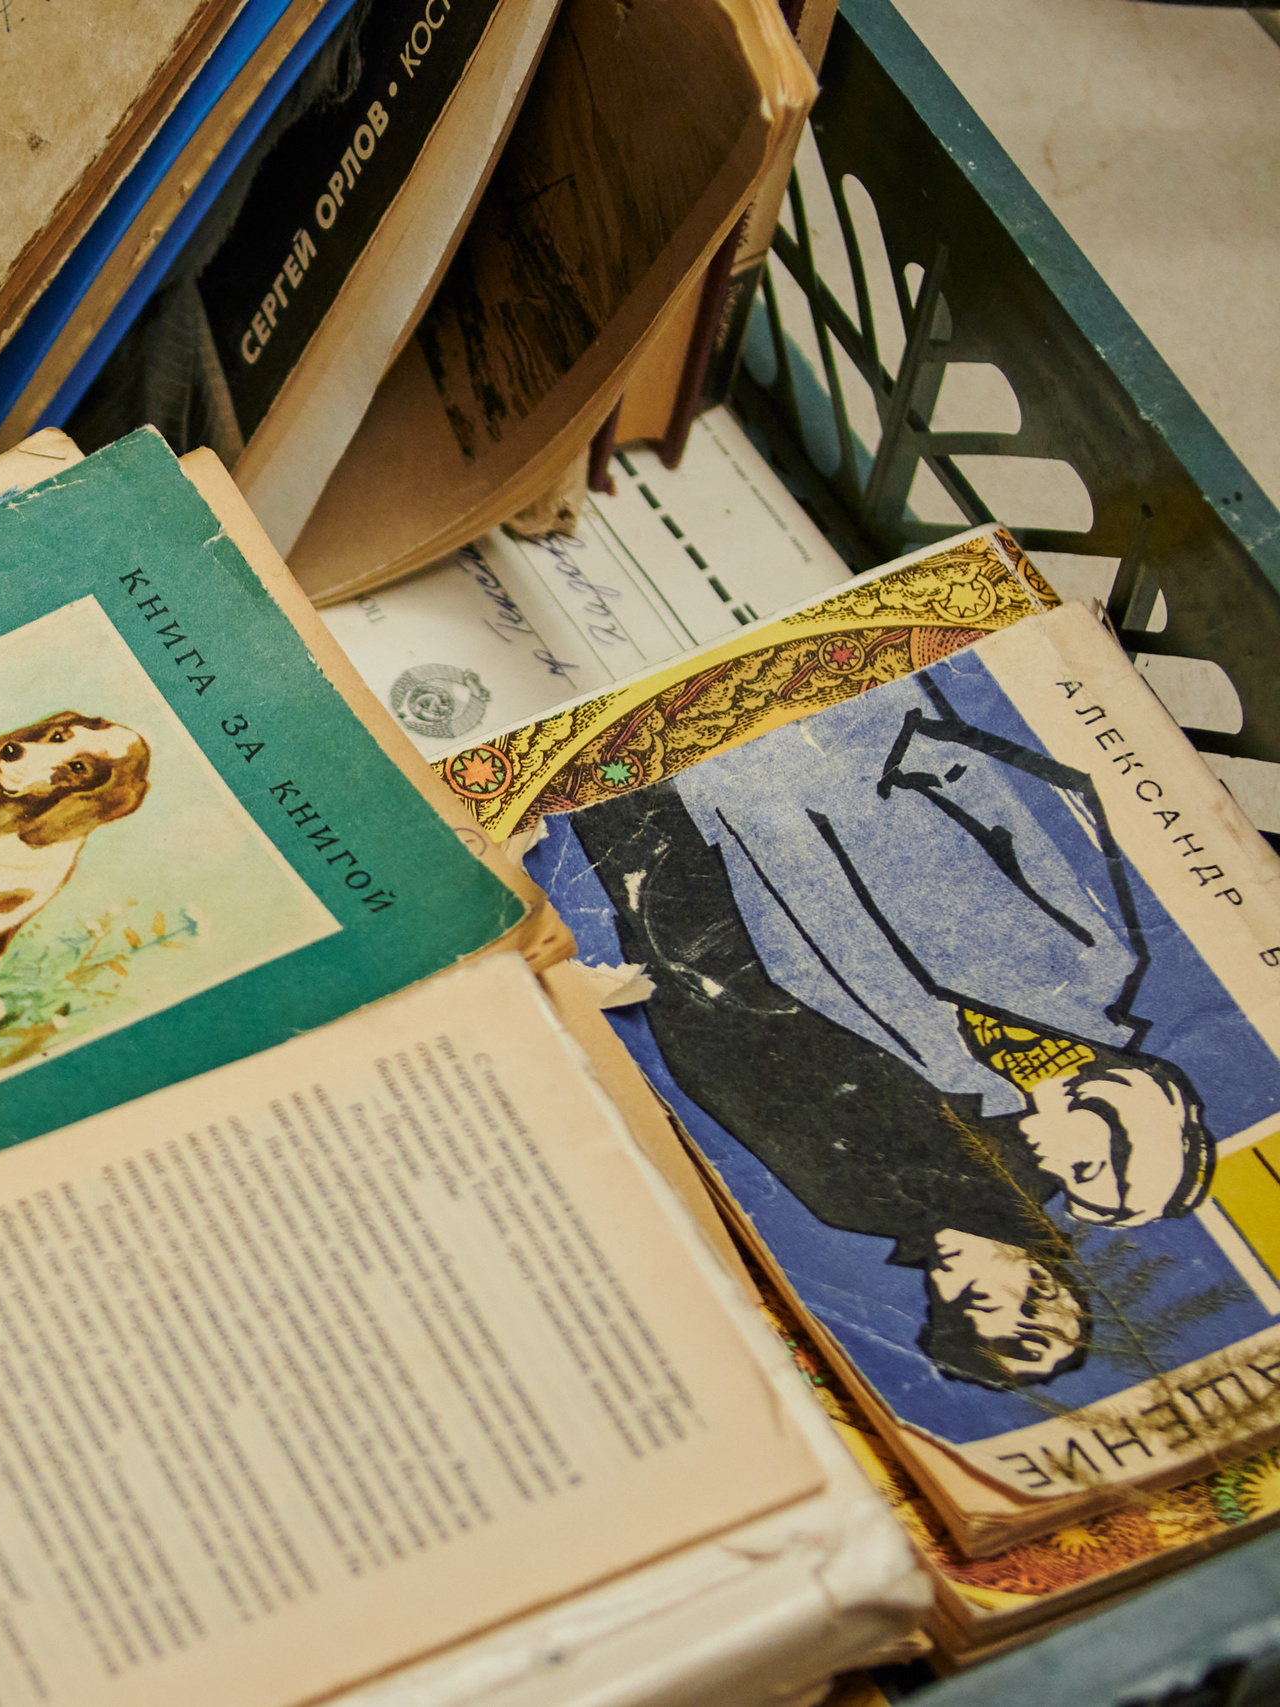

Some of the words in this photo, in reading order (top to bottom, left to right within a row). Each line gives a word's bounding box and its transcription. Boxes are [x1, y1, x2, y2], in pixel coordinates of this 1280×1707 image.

[240, 228, 318, 365] СЕРГЕЙ
[315, 100, 389, 230] ОРЛОВ
[399, 0, 452, 78] КОС
[120, 567, 216, 697] КНИГА
[221, 713, 266, 763] ЗА
[269, 779, 398, 913] КНИГОЙ
[1055, 679, 1245, 909] АЛЕКСАНДР
